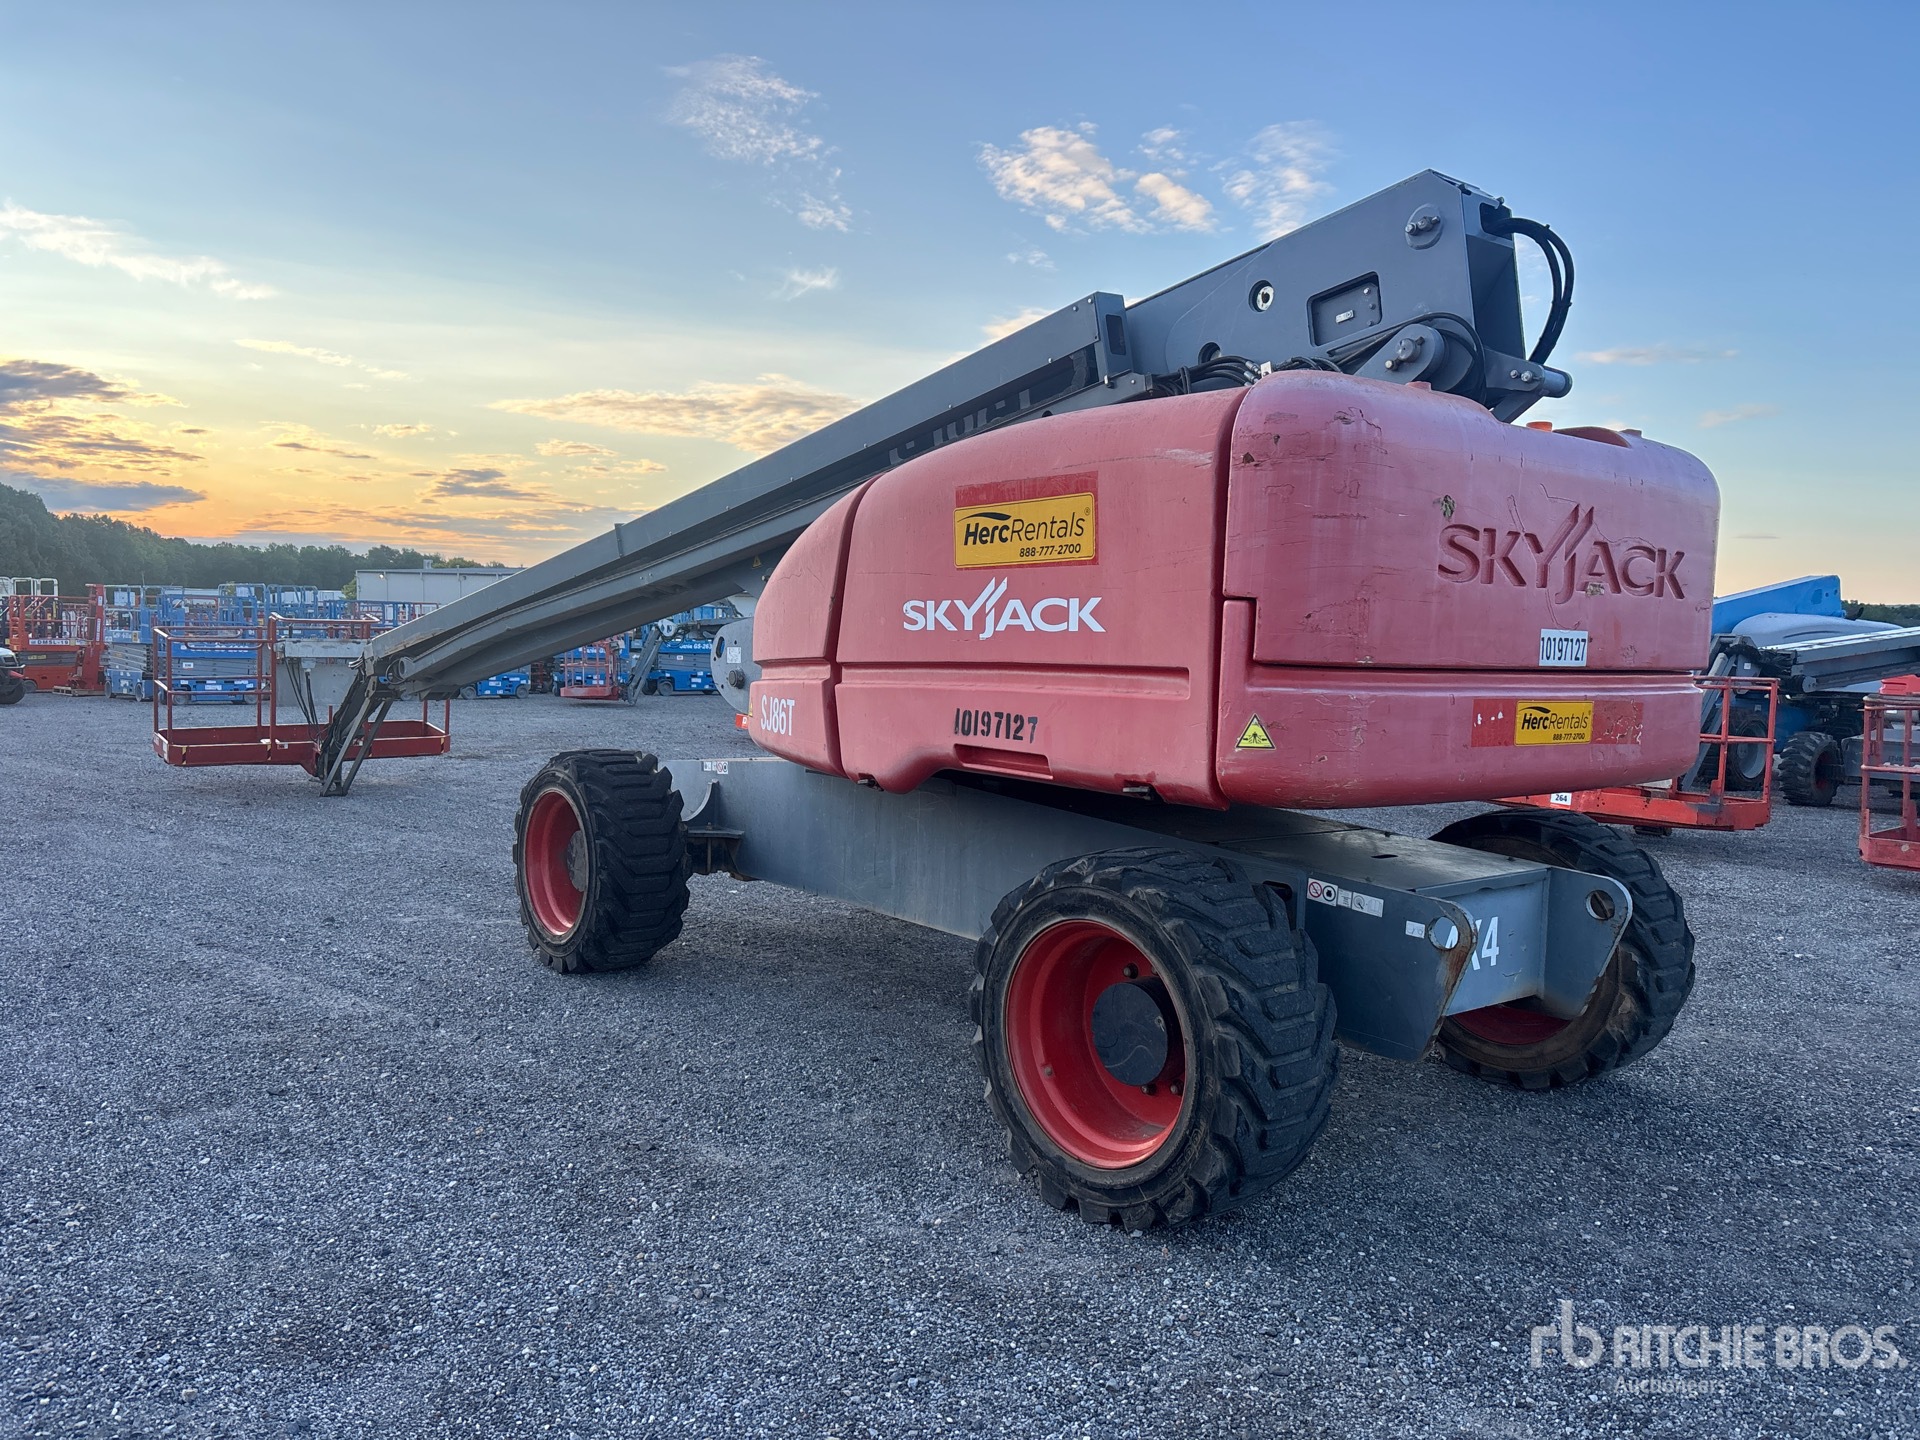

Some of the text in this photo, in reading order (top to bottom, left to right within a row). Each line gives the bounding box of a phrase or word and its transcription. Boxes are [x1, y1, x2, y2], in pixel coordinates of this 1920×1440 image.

[963, 512, 1085, 546] HercRentals
[1019, 543, 1082, 559] 888-777-2700
[1437, 504, 1686, 605] SKYJACK
[902, 577, 1106, 640] SKYJACK
[1539, 635, 1588, 663] 10197127
[760, 694, 796, 737] SJ86T
[953, 707, 1039, 744] 10197127
[1552, 733, 1586, 741] 888-777-2700
[1555, 793, 1568, 802] 264
